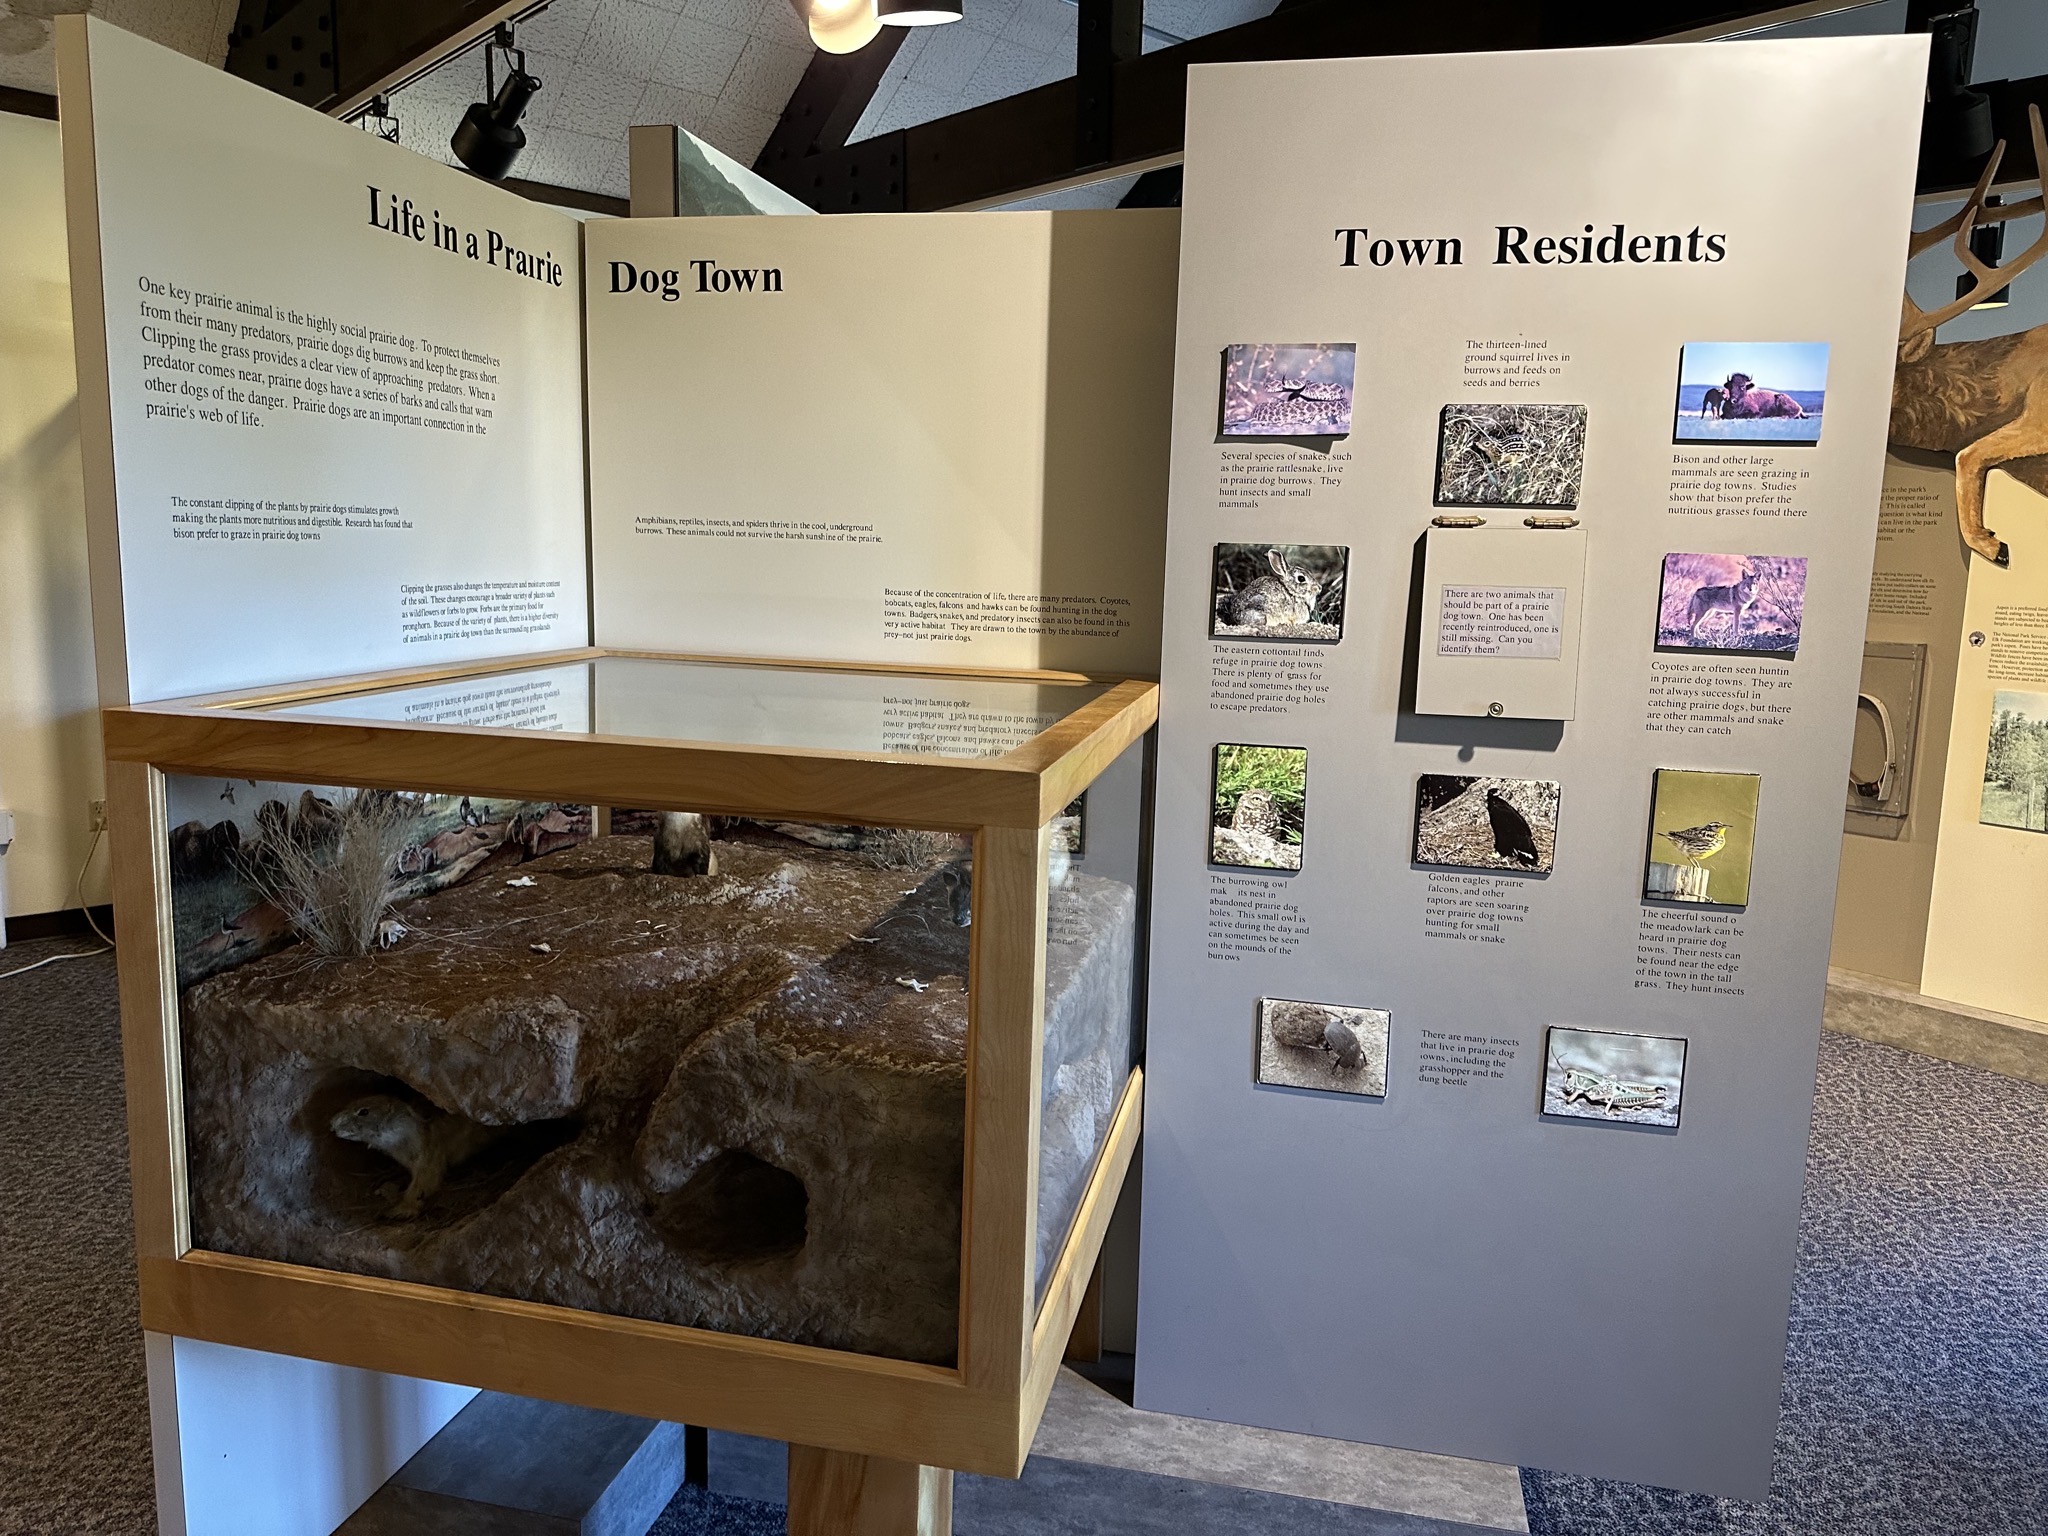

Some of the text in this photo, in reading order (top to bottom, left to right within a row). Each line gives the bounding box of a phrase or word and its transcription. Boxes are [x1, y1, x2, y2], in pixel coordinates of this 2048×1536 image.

[367, 185, 562, 287] Life in a Prairie
[1335, 224, 1726, 267] Town Residents
[608, 260, 783, 302] Dog Town
[139, 276, 500, 367] One key prairie animal is the highly social prairie dog. To protect themselves
[1466, 340, 1483, 349] The
[1464, 352, 1570, 364] ground squirrel lives in
[1464, 365, 1501, 374] burrows
[1503, 365, 1520, 374] and
[1523, 365, 1547, 374] feeds
[1463, 378, 1540, 387] seeds and berries
[146, 403, 264, 428] prairie's web of life.
[1221, 451, 1252, 460] Several
[1255, 454, 1285, 462] species
[1287, 452, 1297, 460] of
[1332, 452, 1352, 461] such
[1673, 454, 1774, 467] Bison and other large
[1668, 507, 1807, 517] nutritious grasses found there
[732, 519, 745, 527] and
[746, 520, 769, 529] spiders
[770, 520, 790, 529] thrive
[791, 521, 798, 529] in
[829, 523, 873, 533] underground
[173, 527, 195, 538] bison
[196, 528, 219, 541] prefer
[220, 530, 229, 539] to
[230, 531, 251, 541] graze
[262, 530, 285, 541] prairie
[286, 530, 299, 542] dog
[300, 532, 321, 540] towns
[1445, 589, 1469, 598] There
[1503, 591, 1536, 599] animals
[1538, 591, 1554, 599] that
[1441, 633, 1457, 642] still
[1498, 634, 1515, 643] Can
[1517, 637, 1533, 645] you
[1213, 645, 1324, 657] The eastern cottontail finds
[1441, 645, 1500, 654] identify them?
[1666, 687, 1699, 698] always
[1701, 690, 1749, 699] successful
[1752, 690, 1761, 699] in
[1220, 704, 1247, 713] escape
[1210, 875, 1287, 889] The burrowing owl
[1428, 873, 1460, 883] Golden
[1495, 880, 1524, 888] prairie
[1464, 888, 1480, 896] and
[1482, 889, 1504, 898] other
[1209, 897, 1253, 908] abandoned
[1283, 903, 1298, 913] dog
[1640, 921, 1654, 930] the
[1656, 923, 1711, 934] meadowlark
[1733, 928, 1744, 936] be
[1666, 981, 1689, 993] They
[1691, 983, 1711, 993] hunt
[1714, 985, 1744, 995] insects
[1419, 1065, 1504, 1079] grasshopper and the
[1418, 1074, 1468, 1086] dung beetle
